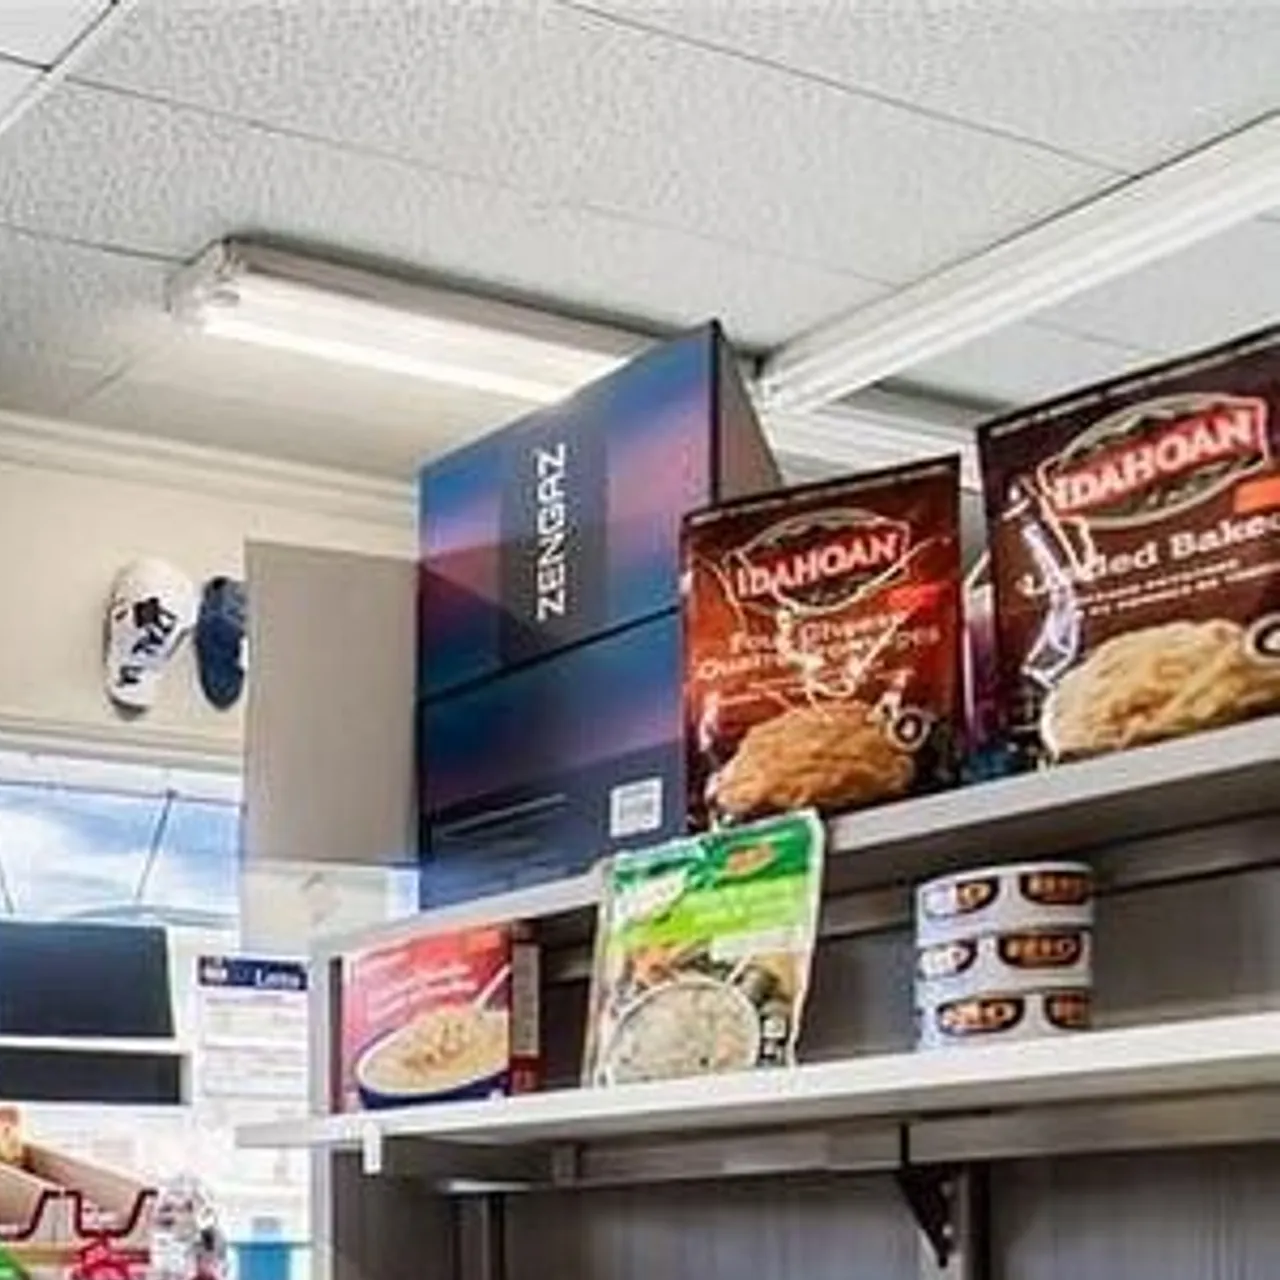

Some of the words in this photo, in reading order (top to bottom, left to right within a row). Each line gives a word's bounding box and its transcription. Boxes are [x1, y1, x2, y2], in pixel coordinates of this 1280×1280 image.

[1052, 409, 1253, 511] IDAHOAN
[536, 442, 569, 622] ZENGAZ
[737, 531, 901, 597] IDAHOAN
